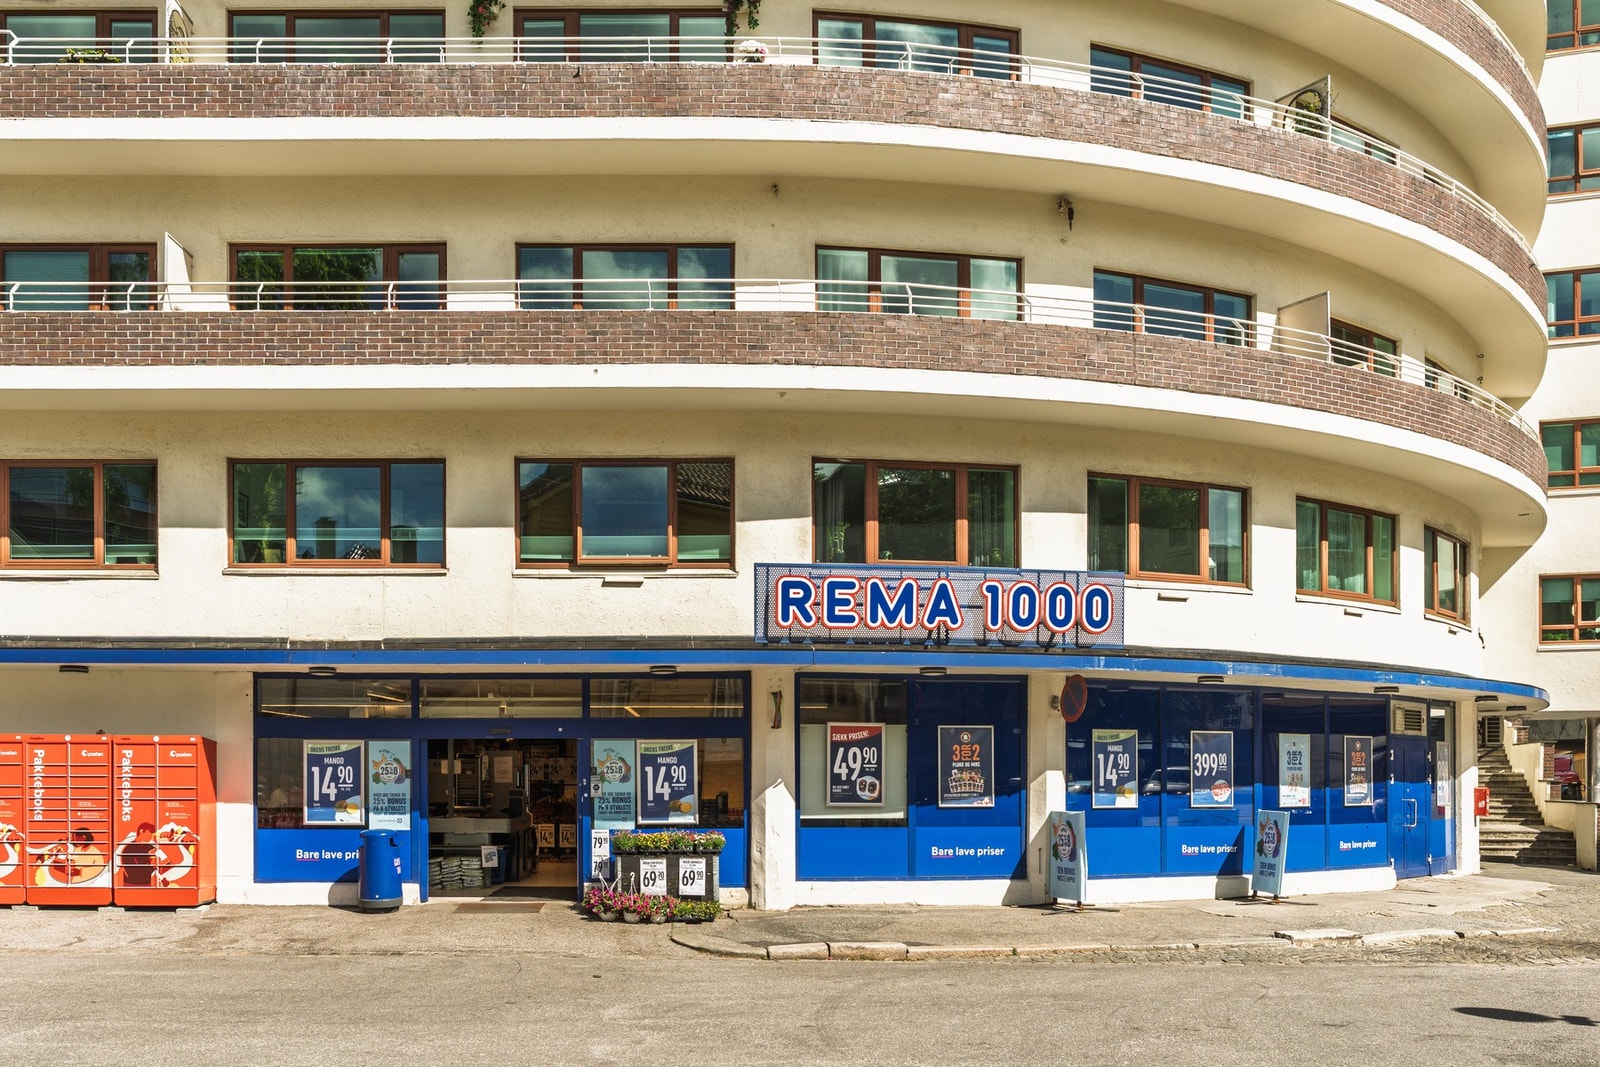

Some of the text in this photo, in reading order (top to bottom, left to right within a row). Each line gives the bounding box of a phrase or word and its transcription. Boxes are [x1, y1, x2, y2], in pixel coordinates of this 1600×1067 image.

[775, 575, 1113, 634] REMA 1000
[832, 730, 869, 741] SJEKK PRISEN!
[952, 744, 980, 761] 3 FOR 2
[1287, 751, 1291, 765] 3
[1298, 751, 1302, 765] 2
[1351, 752, 1355, 766] 3
[1362, 752, 1366, 766] 2
[381, 767, 389, 775] 25
[393, 767, 398, 775] 8
[606, 766, 614, 775] 25
[618, 766, 623, 775] 8
[833, 747, 877, 781] 49 90
[1098, 753, 1129, 787] 14 90
[1194, 753, 1227, 776] 399 00
[34, 750, 44, 820] Pakkeboks
[122, 750, 133, 822] Pakkeboks
[312, 766, 353, 801] 14 90
[645, 765, 687, 801] 14 90
[539, 831, 548, 843] 14
[561, 831, 569, 843] 14
[593, 837, 602, 848] 79
[932, 847, 1004, 857] Bare lave priser
[1182, 845, 1237, 854] Bare lave priser
[1340, 841, 1351, 849] Bare
[1363, 840, 1377, 850] priser
[296, 850, 359, 860] Bare lave pri
[594, 862, 602, 873] 79
[643, 871, 656, 887] 69
[682, 870, 695, 886] 69
